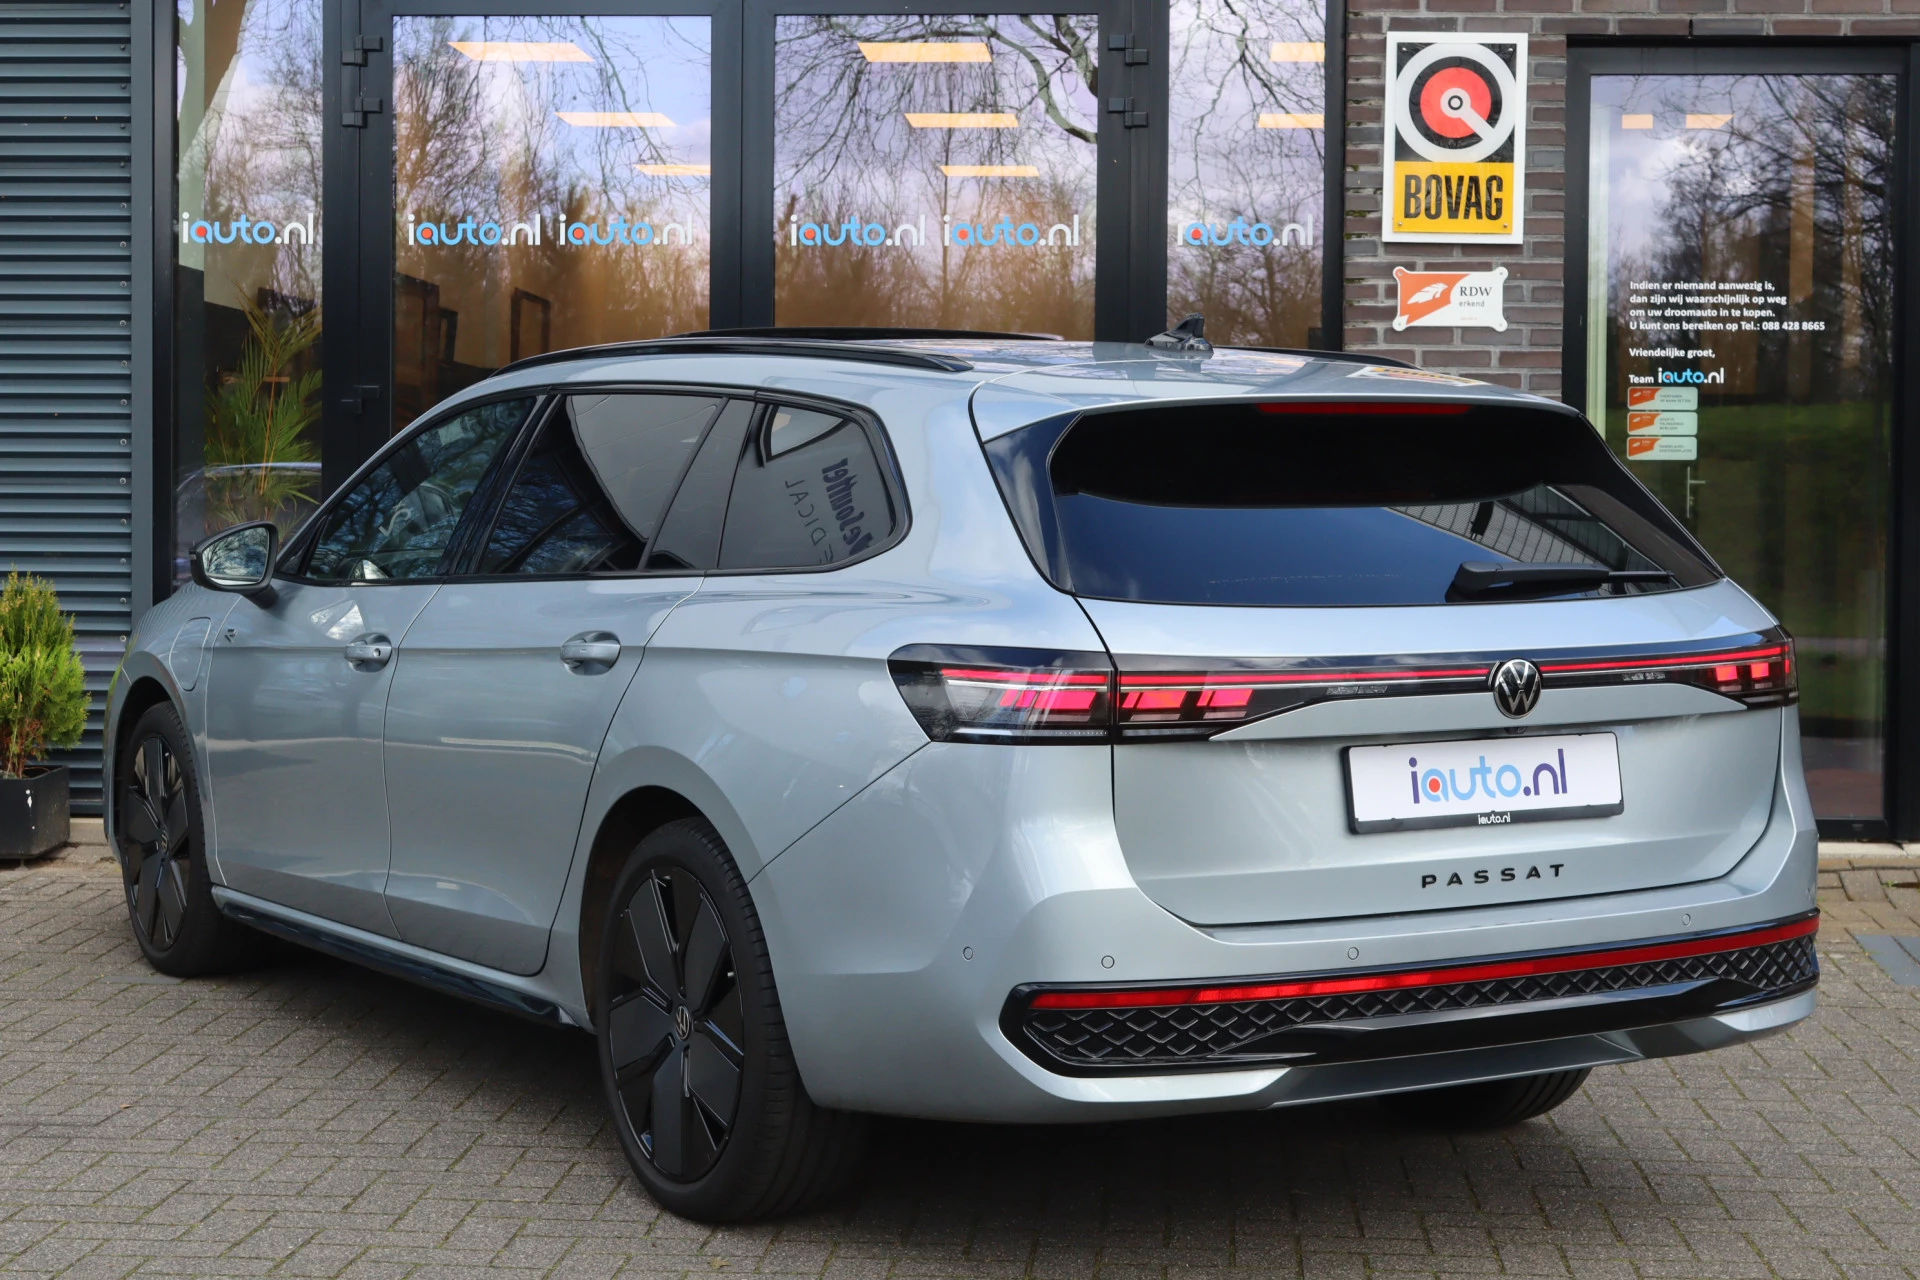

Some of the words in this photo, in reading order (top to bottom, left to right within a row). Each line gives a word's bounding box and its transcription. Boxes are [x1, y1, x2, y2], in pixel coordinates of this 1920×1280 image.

[1403, 174, 1503, 220] BOVAG
[182, 212, 314, 245] iauto.nl
[408, 213, 540, 245] iauto.nl
[559, 213, 692, 245] iauto.nl
[791, 214, 925, 246] iauto.nl
[943, 214, 1079, 246] iauto.nl
[1177, 214, 1313, 246] iauto.nl
[1460, 286, 1492, 297] RDW
[1630, 281, 1660, 289] Indien
[1674, 281, 1716, 289] niemand
[1718, 281, 1762, 291] aanwezig
[1765, 281, 1775, 291] is,
[1630, 294, 1648, 303] dan
[1650, 294, 1666, 305] zijn
[1669, 294, 1683, 305] wij
[1686, 294, 1750, 305] waarschijnlijk
[1752, 296, 1764, 305] op
[1767, 297, 1787, 305] weg
[1665, 308, 1717, 317] droomauto
[1720, 308, 1729, 317] in
[1731, 309, 1741, 317] te
[1743, 308, 1775, 318] kopen.
[1630, 322, 1637, 330] U
[1640, 322, 1661, 330] kunt
[1683, 322, 1723, 330] bereiken
[1741, 322, 1760, 330] Tel.:
[1762, 322, 1779, 330] 088
[1782, 322, 1799, 330] 428
[1802, 322, 1825, 330] 8665
[1629, 348, 1685, 358] Vriendelijke
[1687, 348, 1715, 358] groet,
[1629, 375, 1654, 383] Team
[1658, 367, 1724, 383] iauto.nl
[1408, 748, 1568, 804] iauto.nl
[1477, 811, 1511, 825] iauto.nl
[1421, 863, 1566, 889] PASSAT
